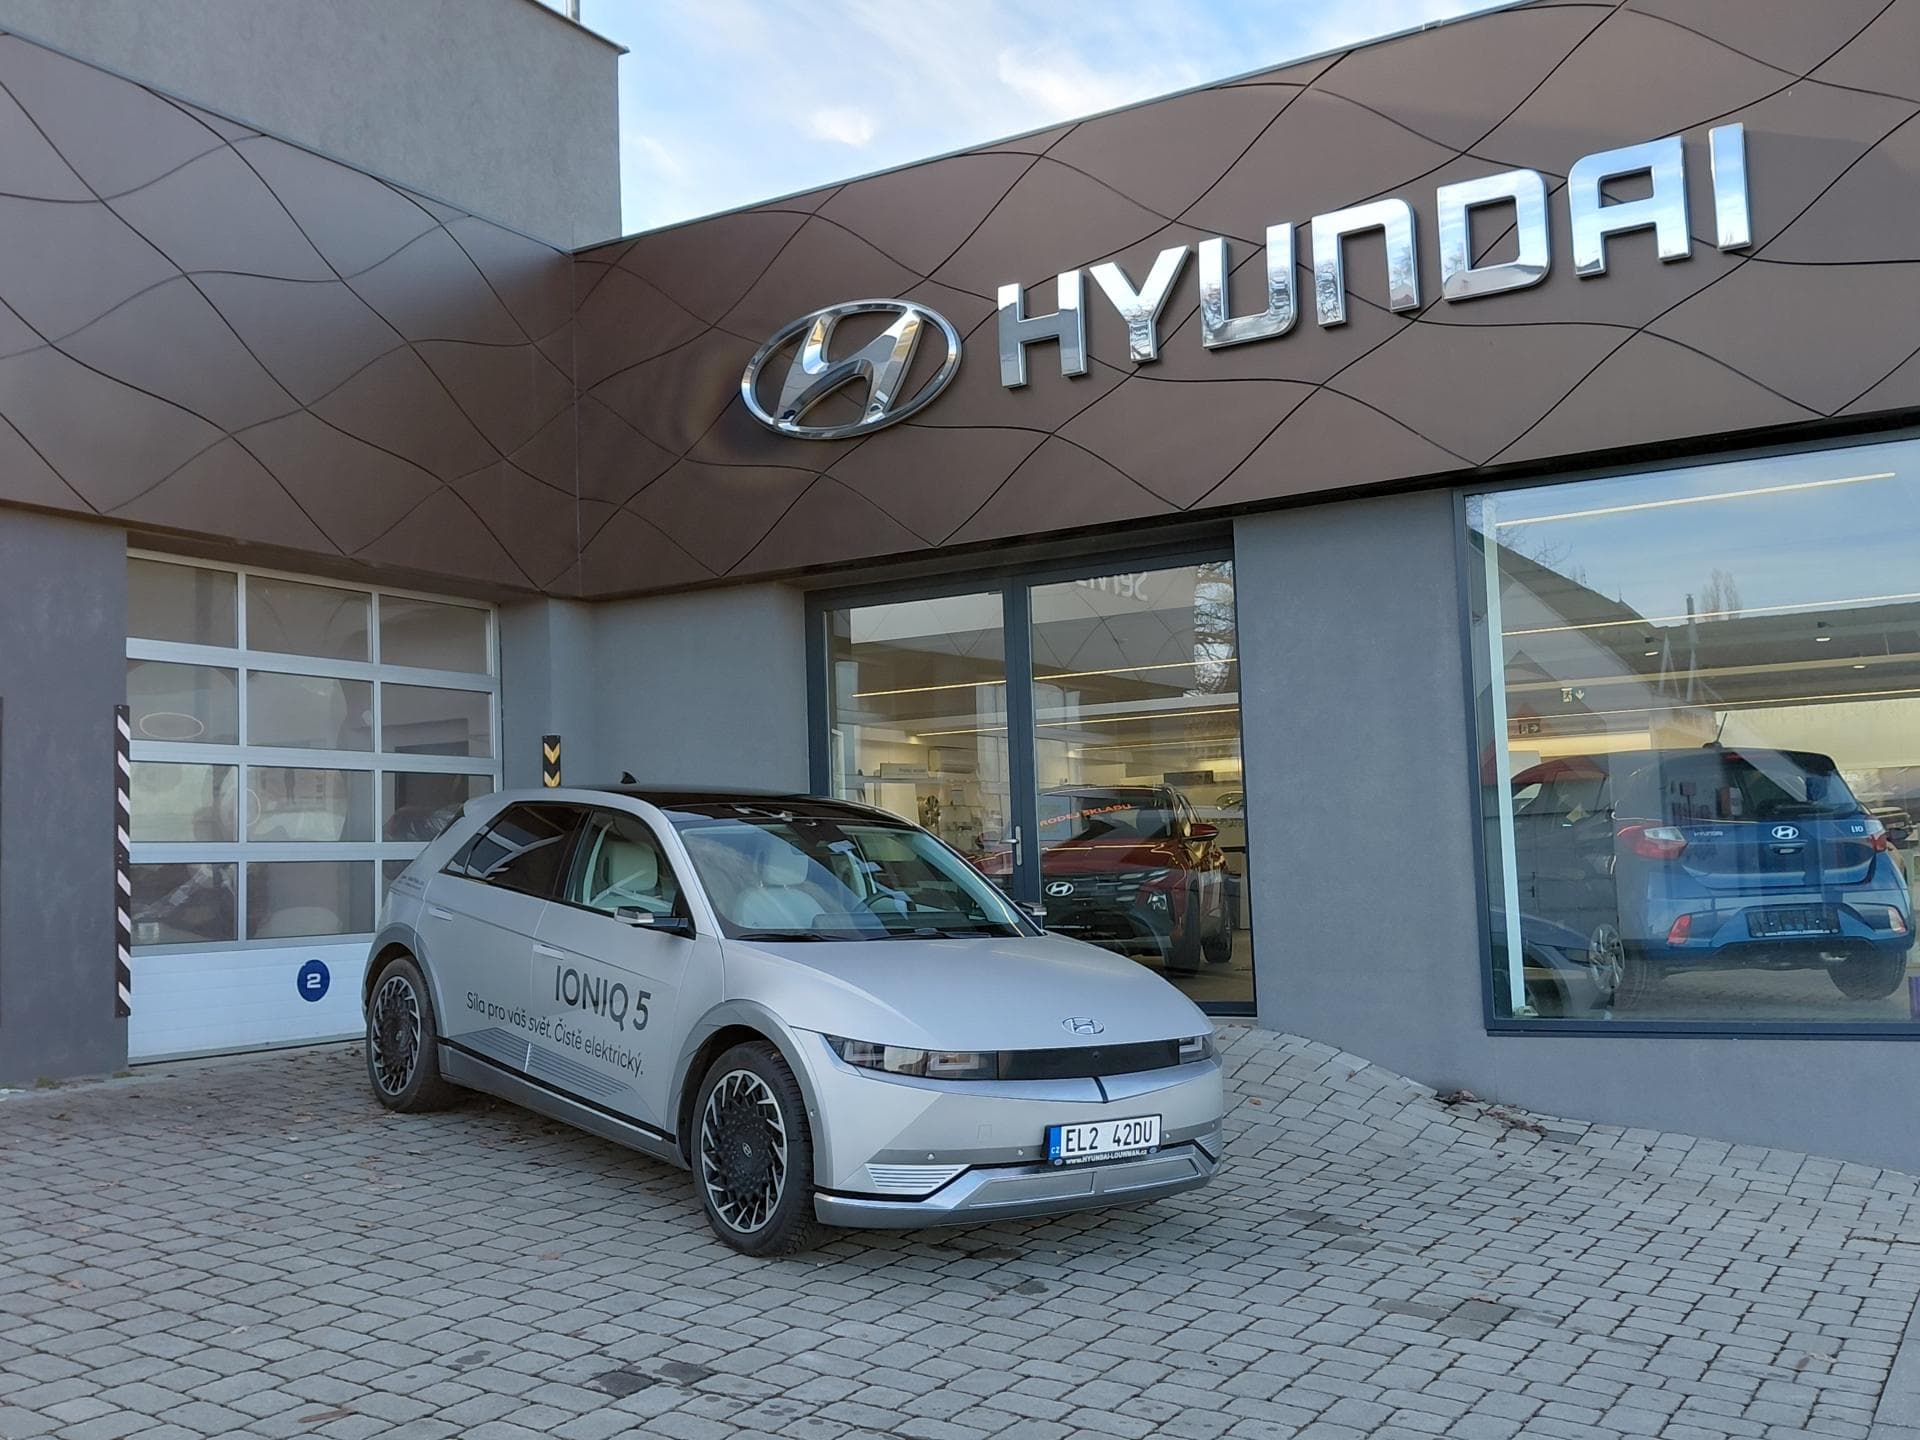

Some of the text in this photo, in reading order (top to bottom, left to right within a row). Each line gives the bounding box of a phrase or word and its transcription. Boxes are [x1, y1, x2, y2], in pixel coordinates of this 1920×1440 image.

[998, 122, 1752, 389] HYUNDAI
[306, 973, 322, 989] 2
[554, 965, 651, 1032] IONIQ 5
[466, 991, 644, 1079] Sila pro váš svět. Čistě elektrický.
[1050, 1145, 1060, 1154] CZ
[1065, 1120, 1153, 1153] EL2 42DU
